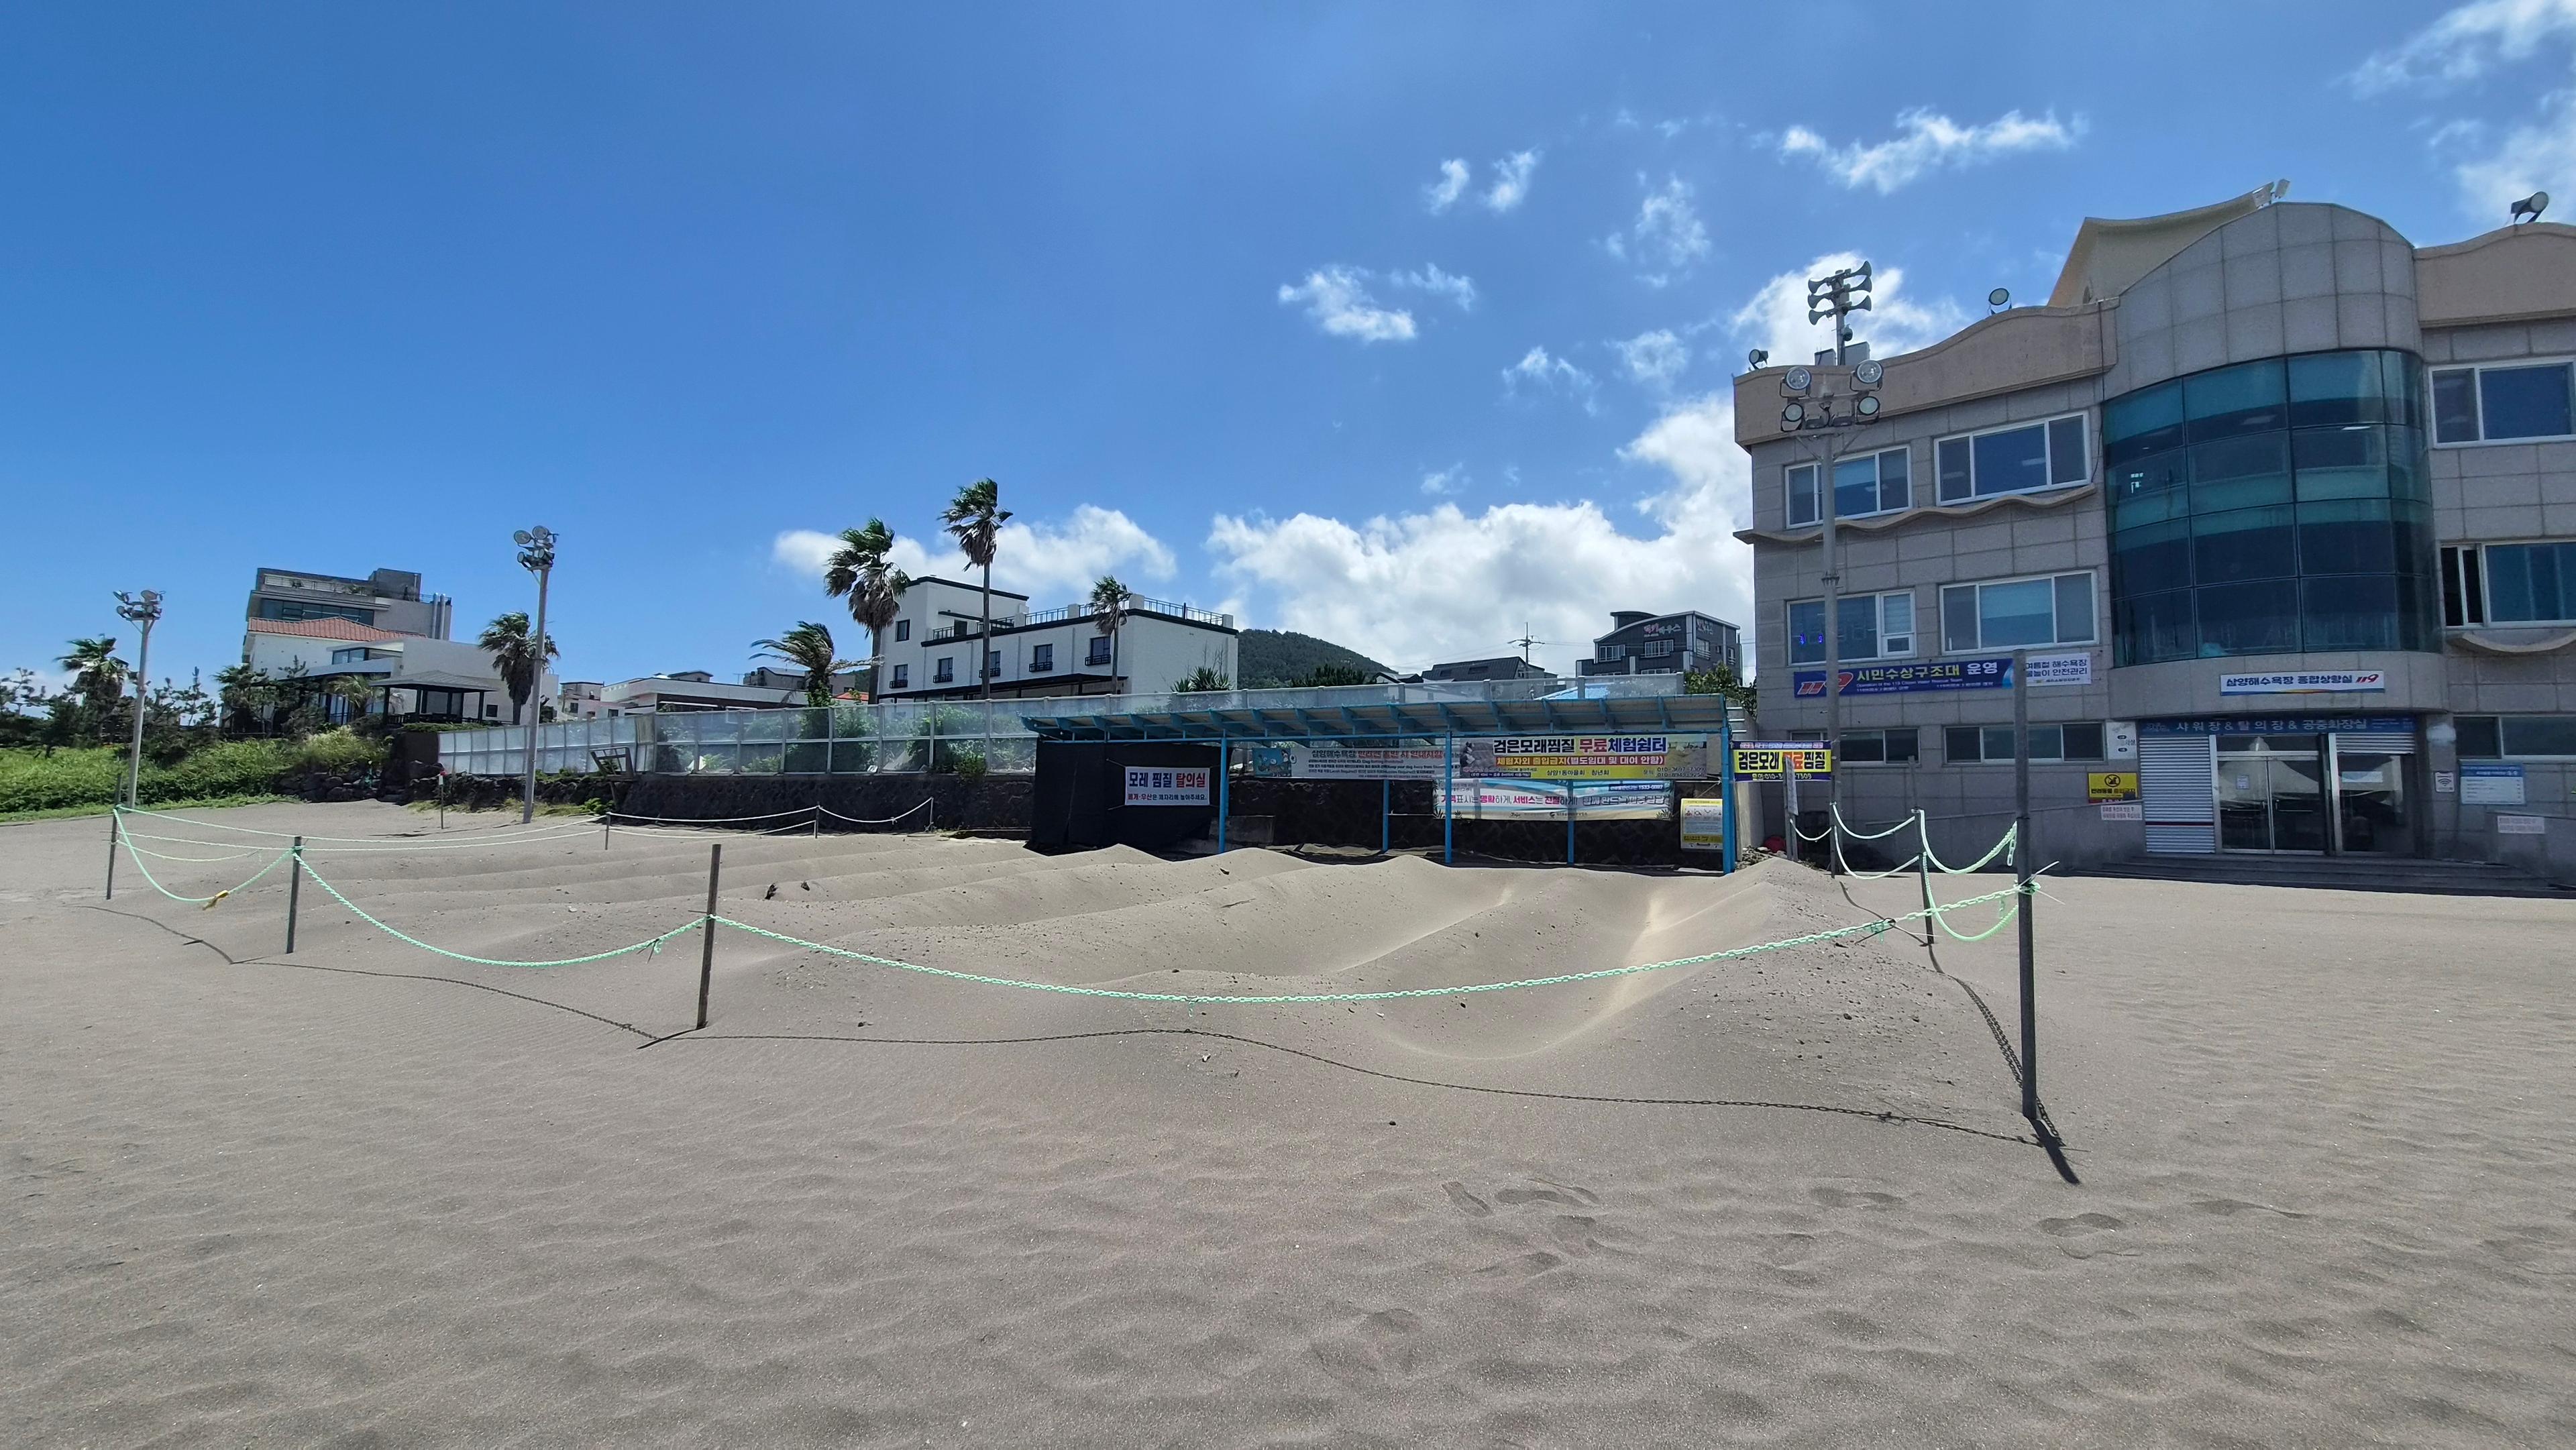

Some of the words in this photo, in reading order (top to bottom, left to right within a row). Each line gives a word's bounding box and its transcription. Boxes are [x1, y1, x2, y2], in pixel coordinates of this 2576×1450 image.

[2052, 659, 2088, 668] 해수욕장
[1857, 664, 1960, 681] 시민수상구조대
[1967, 662, 1998, 675] 운영
[2053, 667, 2088, 676] 안전관리
[2226, 675, 2294, 687] 삼양해수욕장
[2298, 675, 2353, 684] 종합상황실
[2355, 673, 2379, 683] 119
[2302, 718, 2367, 730] 공중화장실
[1493, 738, 1575, 753] 검은모래찜질
[1579, 737, 1666, 752] 무료체험쉼터
[1497, 757, 1530, 765] 체험자외
[1609, 756, 1617, 764] 및
[1640, 756, 1664, 765] 안함)
[1738, 752, 1780, 770] 검은모래
[1129, 772, 1148, 788] 모레
[1152, 773, 1173, 788] 찜질
[1176, 773, 1206, 788] 탈의실
[1513, 795, 1543, 804] 서비스는
